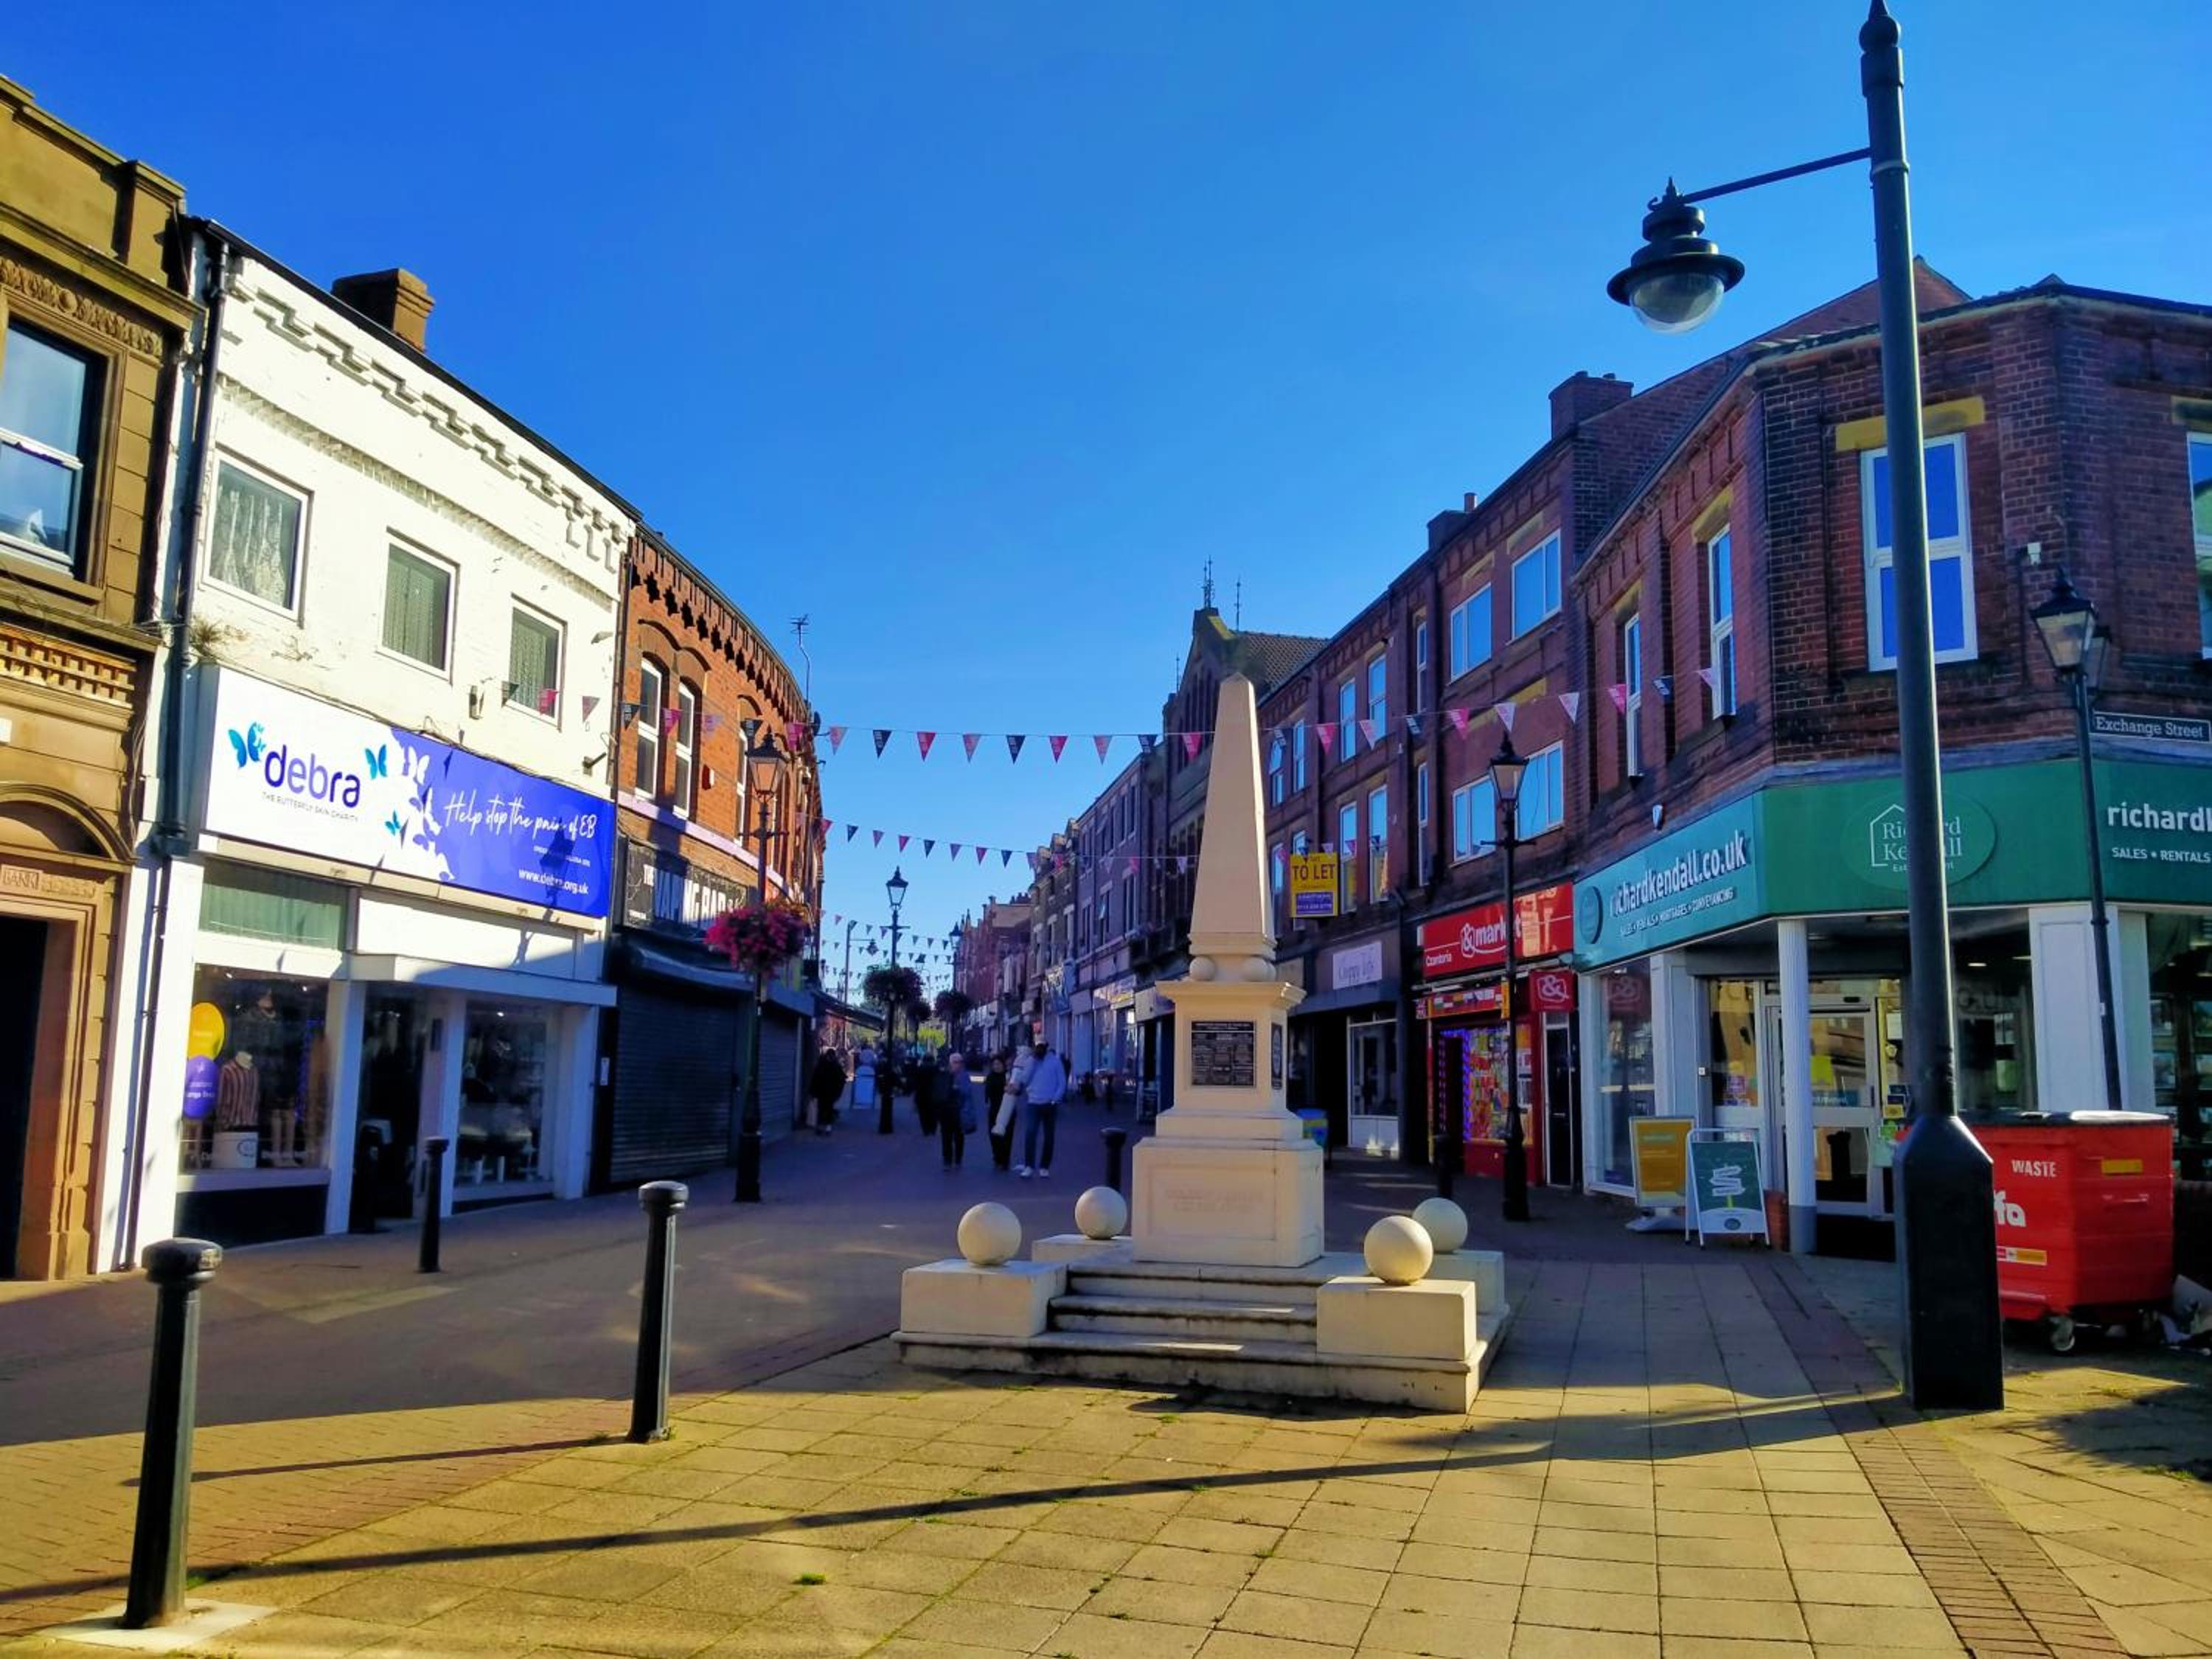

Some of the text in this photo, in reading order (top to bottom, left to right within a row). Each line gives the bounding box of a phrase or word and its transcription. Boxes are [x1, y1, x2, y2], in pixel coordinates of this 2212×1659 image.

[2096, 716, 2203, 737] Exchange Street
[264, 744, 361, 808] debra
[444, 789, 483, 836] Help
[486, 794, 509, 835] stop
[508, 796, 533, 835] the
[568, 815, 579, 841] of
[579, 814, 597, 838] EB
[1884, 838, 1962, 860] Kell
[2112, 848, 2211, 863] SALES RENTALS
[1291, 863, 1335, 881] TO LET
[1610, 830, 1747, 917] richardkendall.co.uk
[2011, 1159, 2057, 1178] WASTE
